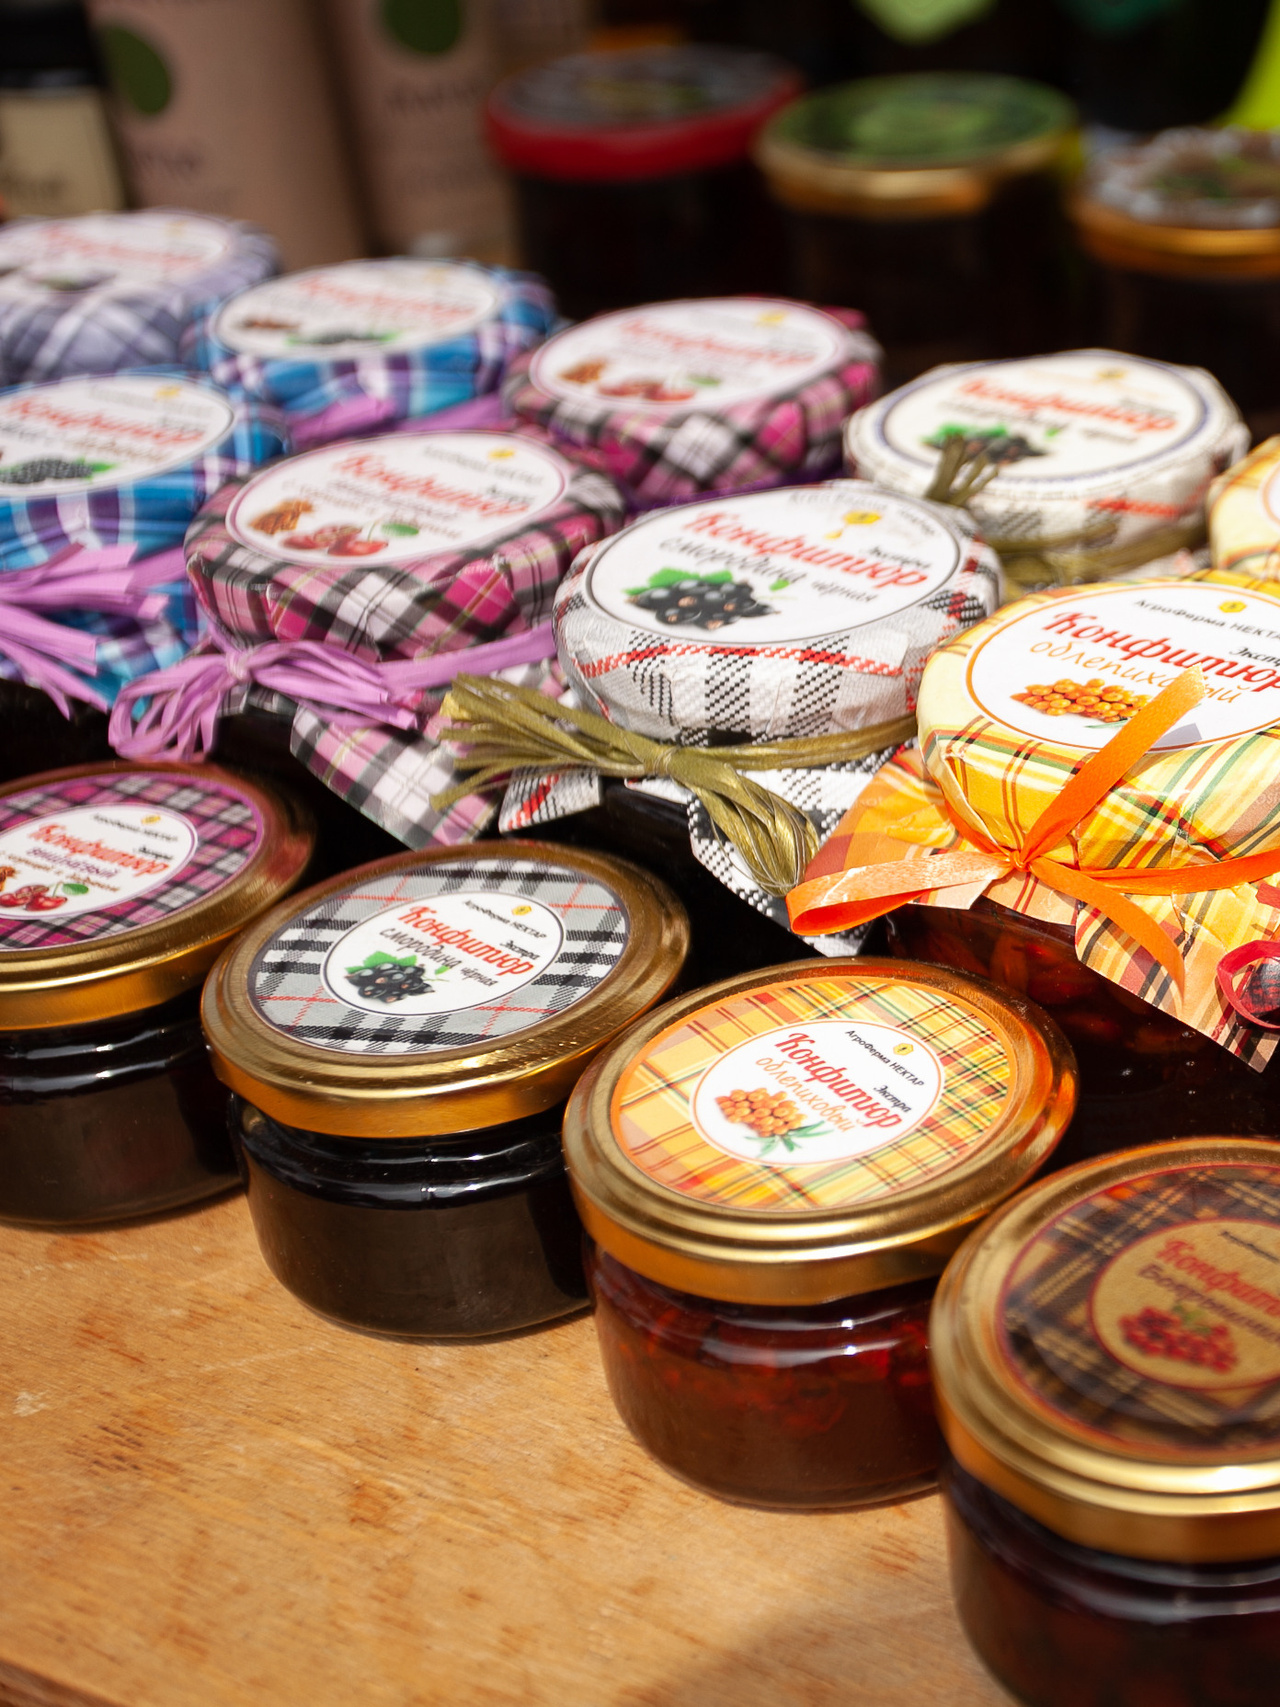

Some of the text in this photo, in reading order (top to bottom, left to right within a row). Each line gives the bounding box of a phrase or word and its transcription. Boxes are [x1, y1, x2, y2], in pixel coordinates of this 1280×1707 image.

[333, 453, 529, 518] Конфитюр
[660, 536, 806, 585] смородина
[683, 510, 928, 589] Конфитюр
[1134, 598, 1226, 628] АгроФерма
[1029, 641, 1243, 704] облепихоый
[29, 823, 170, 877] Конфитюр
[379, 927, 499, 988] смородина чёрная
[397, 905, 535, 977] Конфитюр
[499, 940, 540, 961] Экстра
[755, 1056, 864, 1133] облепиховый
[774, 1032, 903, 1129] Конфитюр
[873, 1084, 912, 1114] Экстра
[889, 1062, 925, 1087] НЕКТАР
